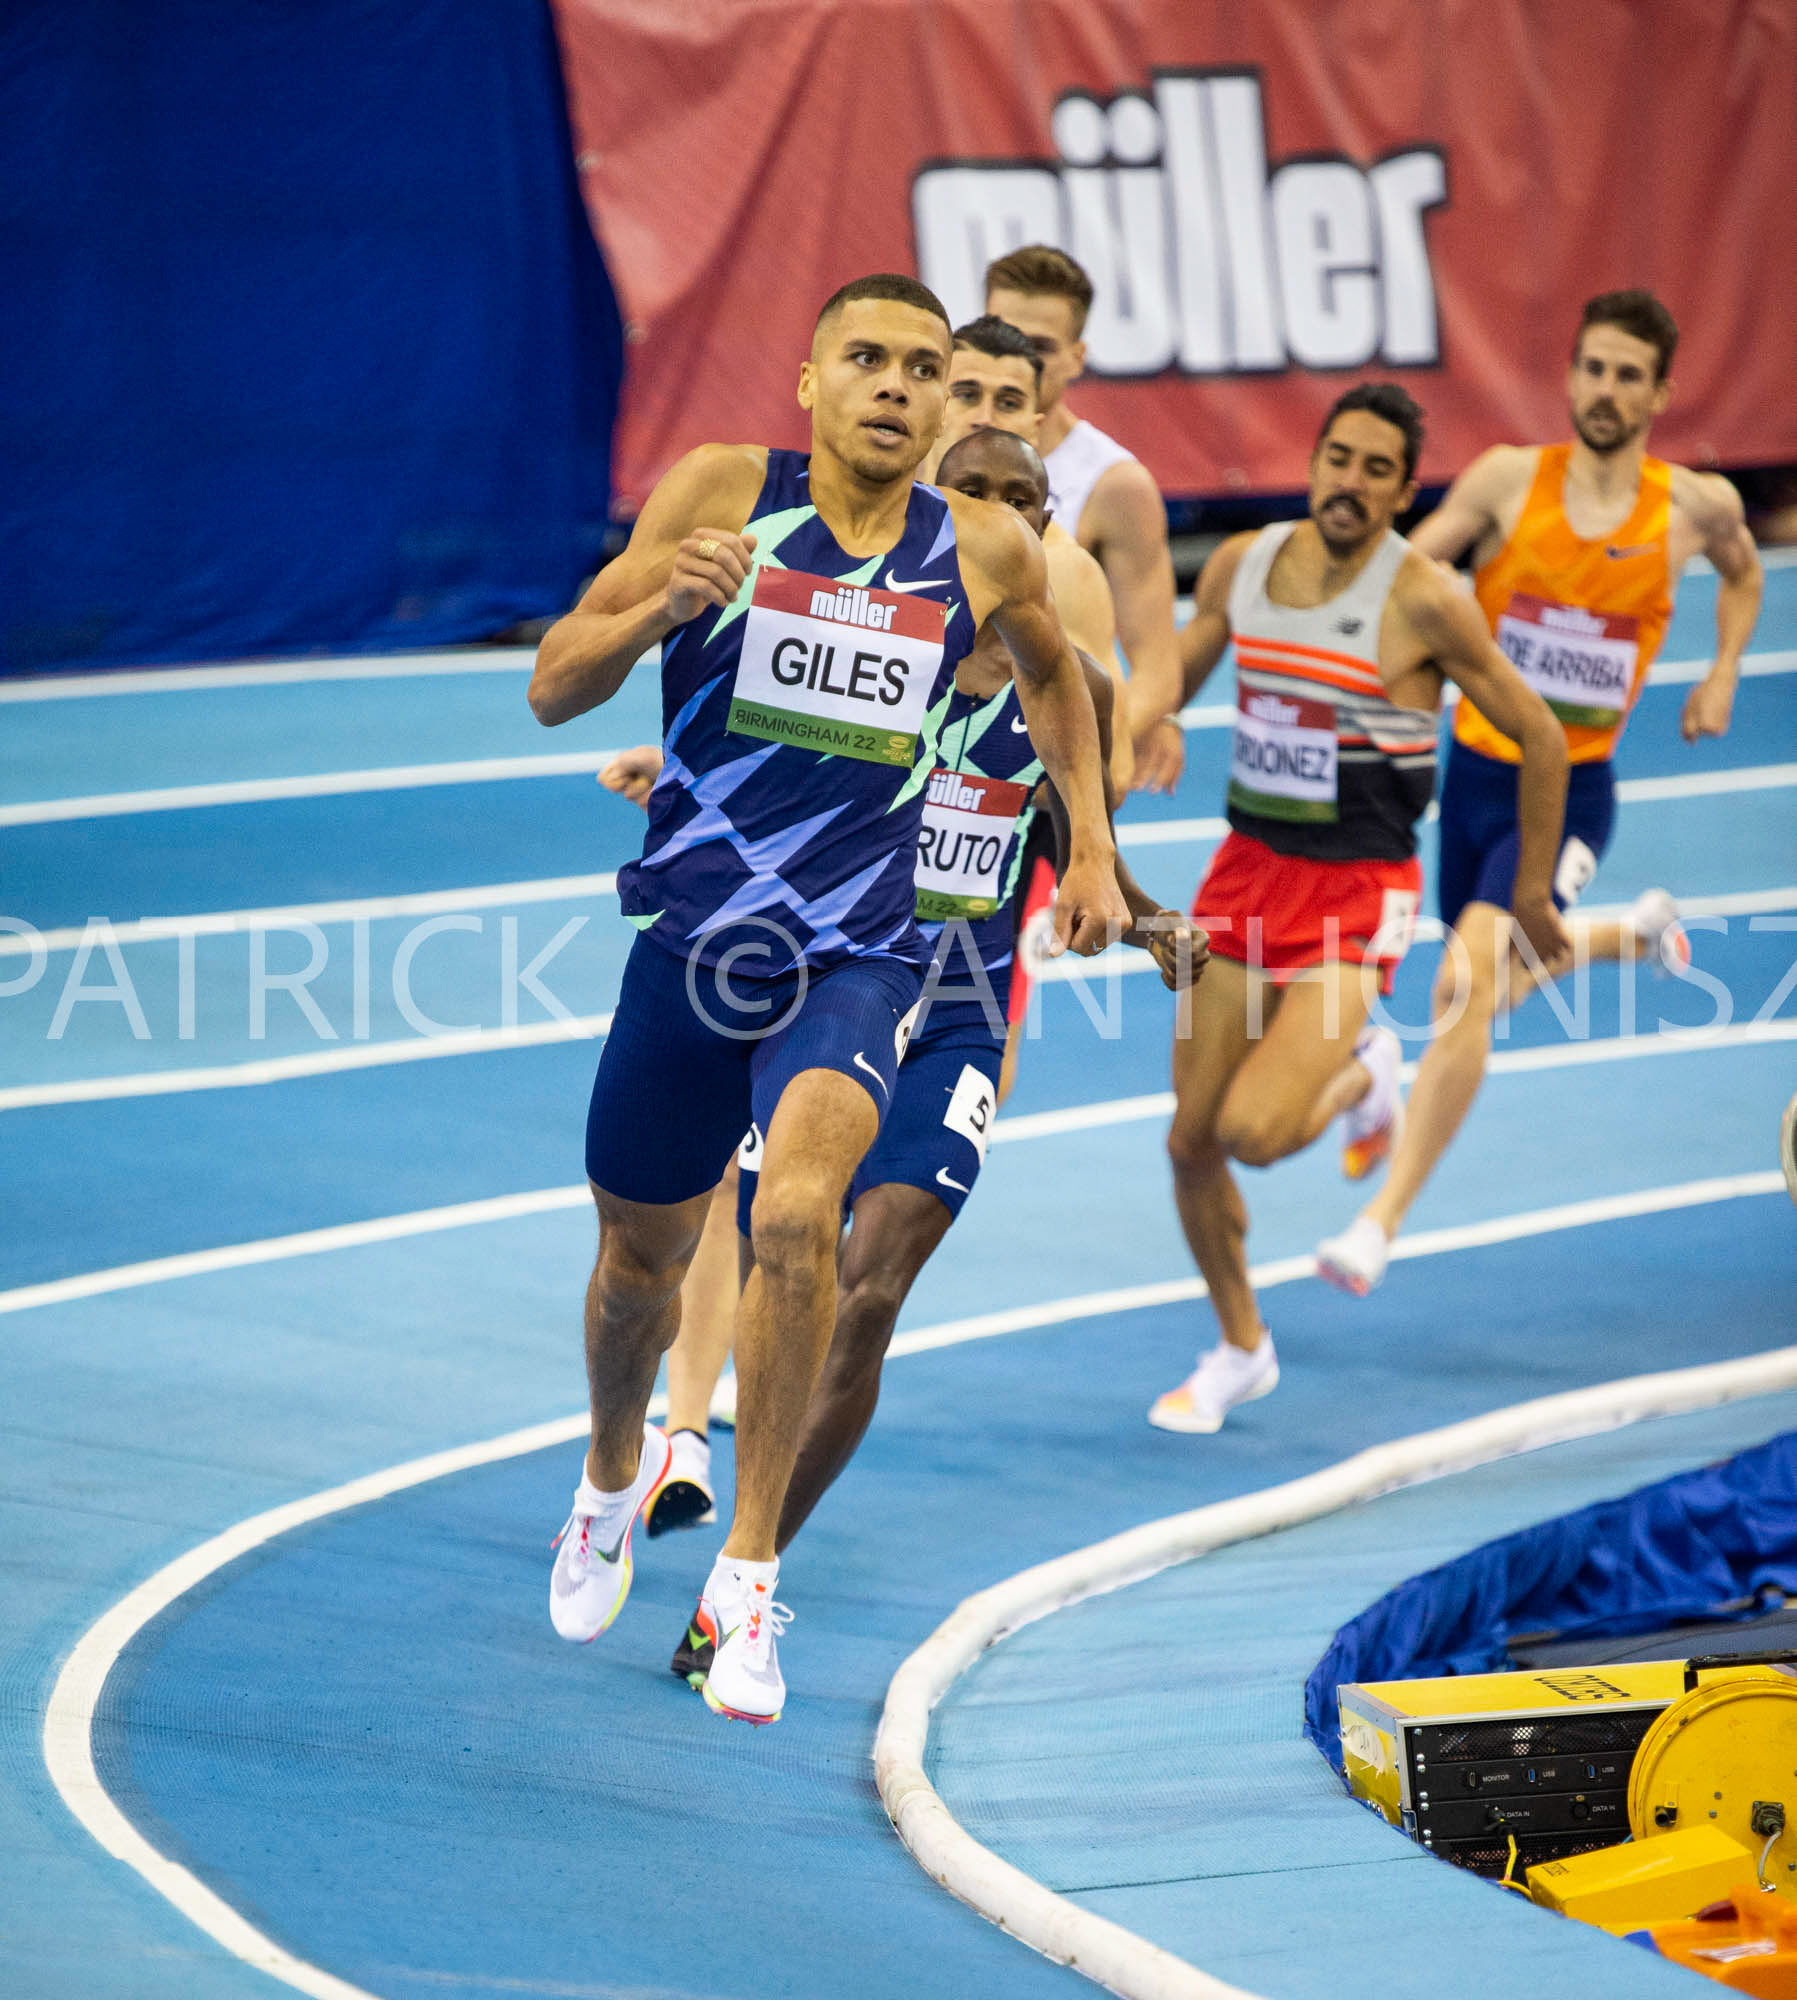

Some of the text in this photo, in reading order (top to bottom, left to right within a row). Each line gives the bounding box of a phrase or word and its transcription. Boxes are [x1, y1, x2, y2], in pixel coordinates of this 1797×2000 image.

[913, 66, 1447, 376] müller
[809, 587, 898, 630] müller
[771, 637, 910, 705] GILES
[1538, 646, 1626, 691] ARRIBA
[735, 708, 876, 751] BIRMINGHAM 22
[926, 773, 986, 812] üller
[917, 825, 1001, 875] RUTO
[969, 1095, 989, 1134] 5
[1482, 1773, 1510, 1782] MONITOR
[1542, 1769, 1556, 1778] USB
[1602, 1766, 1615, 1774] USB
[1592, 1805, 1608, 1813] DATA
